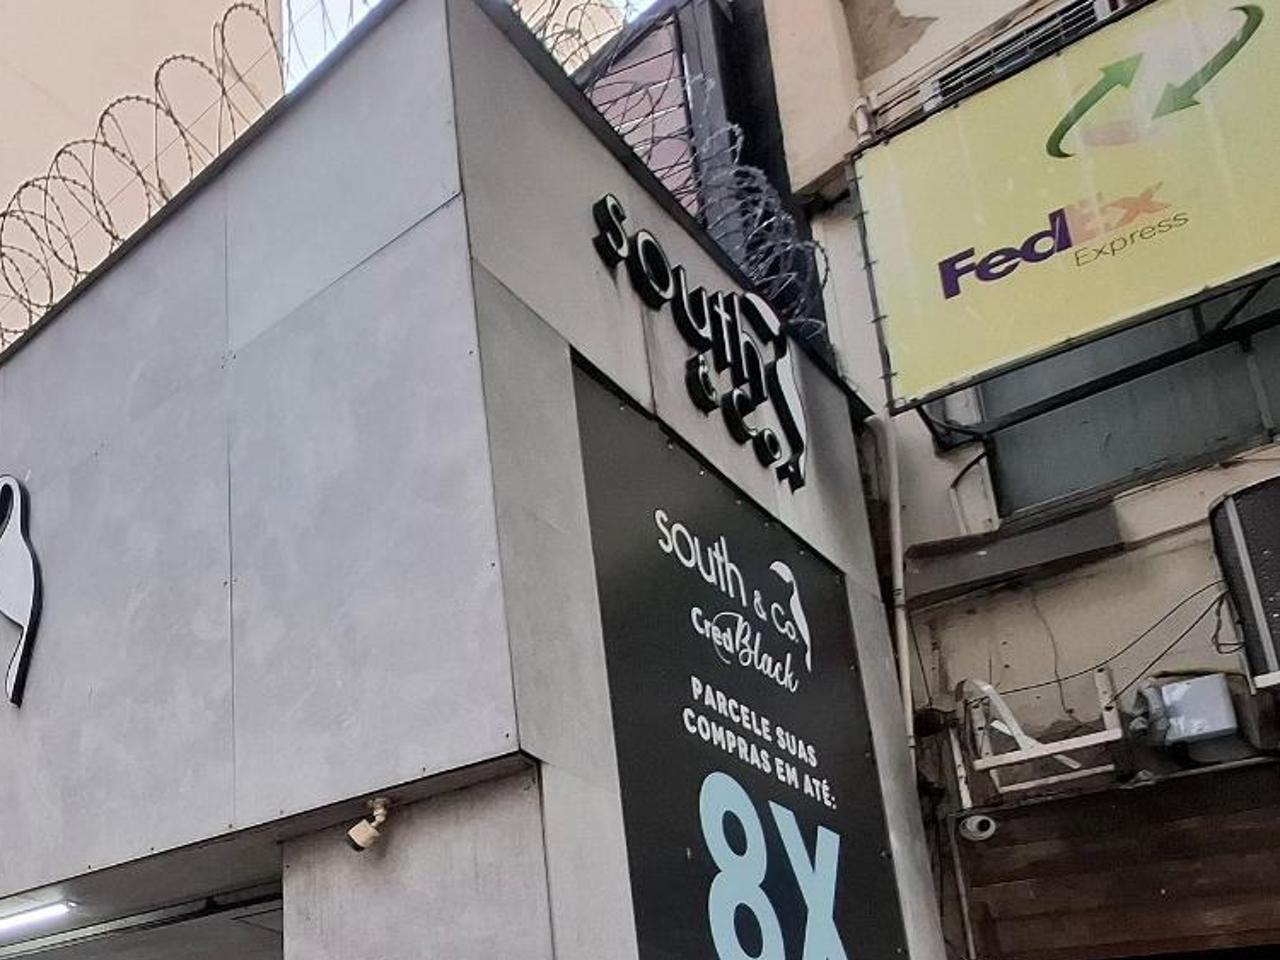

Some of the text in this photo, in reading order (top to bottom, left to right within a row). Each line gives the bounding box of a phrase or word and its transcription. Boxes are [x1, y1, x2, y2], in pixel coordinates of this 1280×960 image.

[938, 182, 1171, 299] FedEx
[1074, 212, 1189, 267] Express
[655, 509, 747, 607] south
[683, 707, 837, 810] COMPRAS EM ATÉ:
[690, 675, 817, 768] PARCELE SUAS
